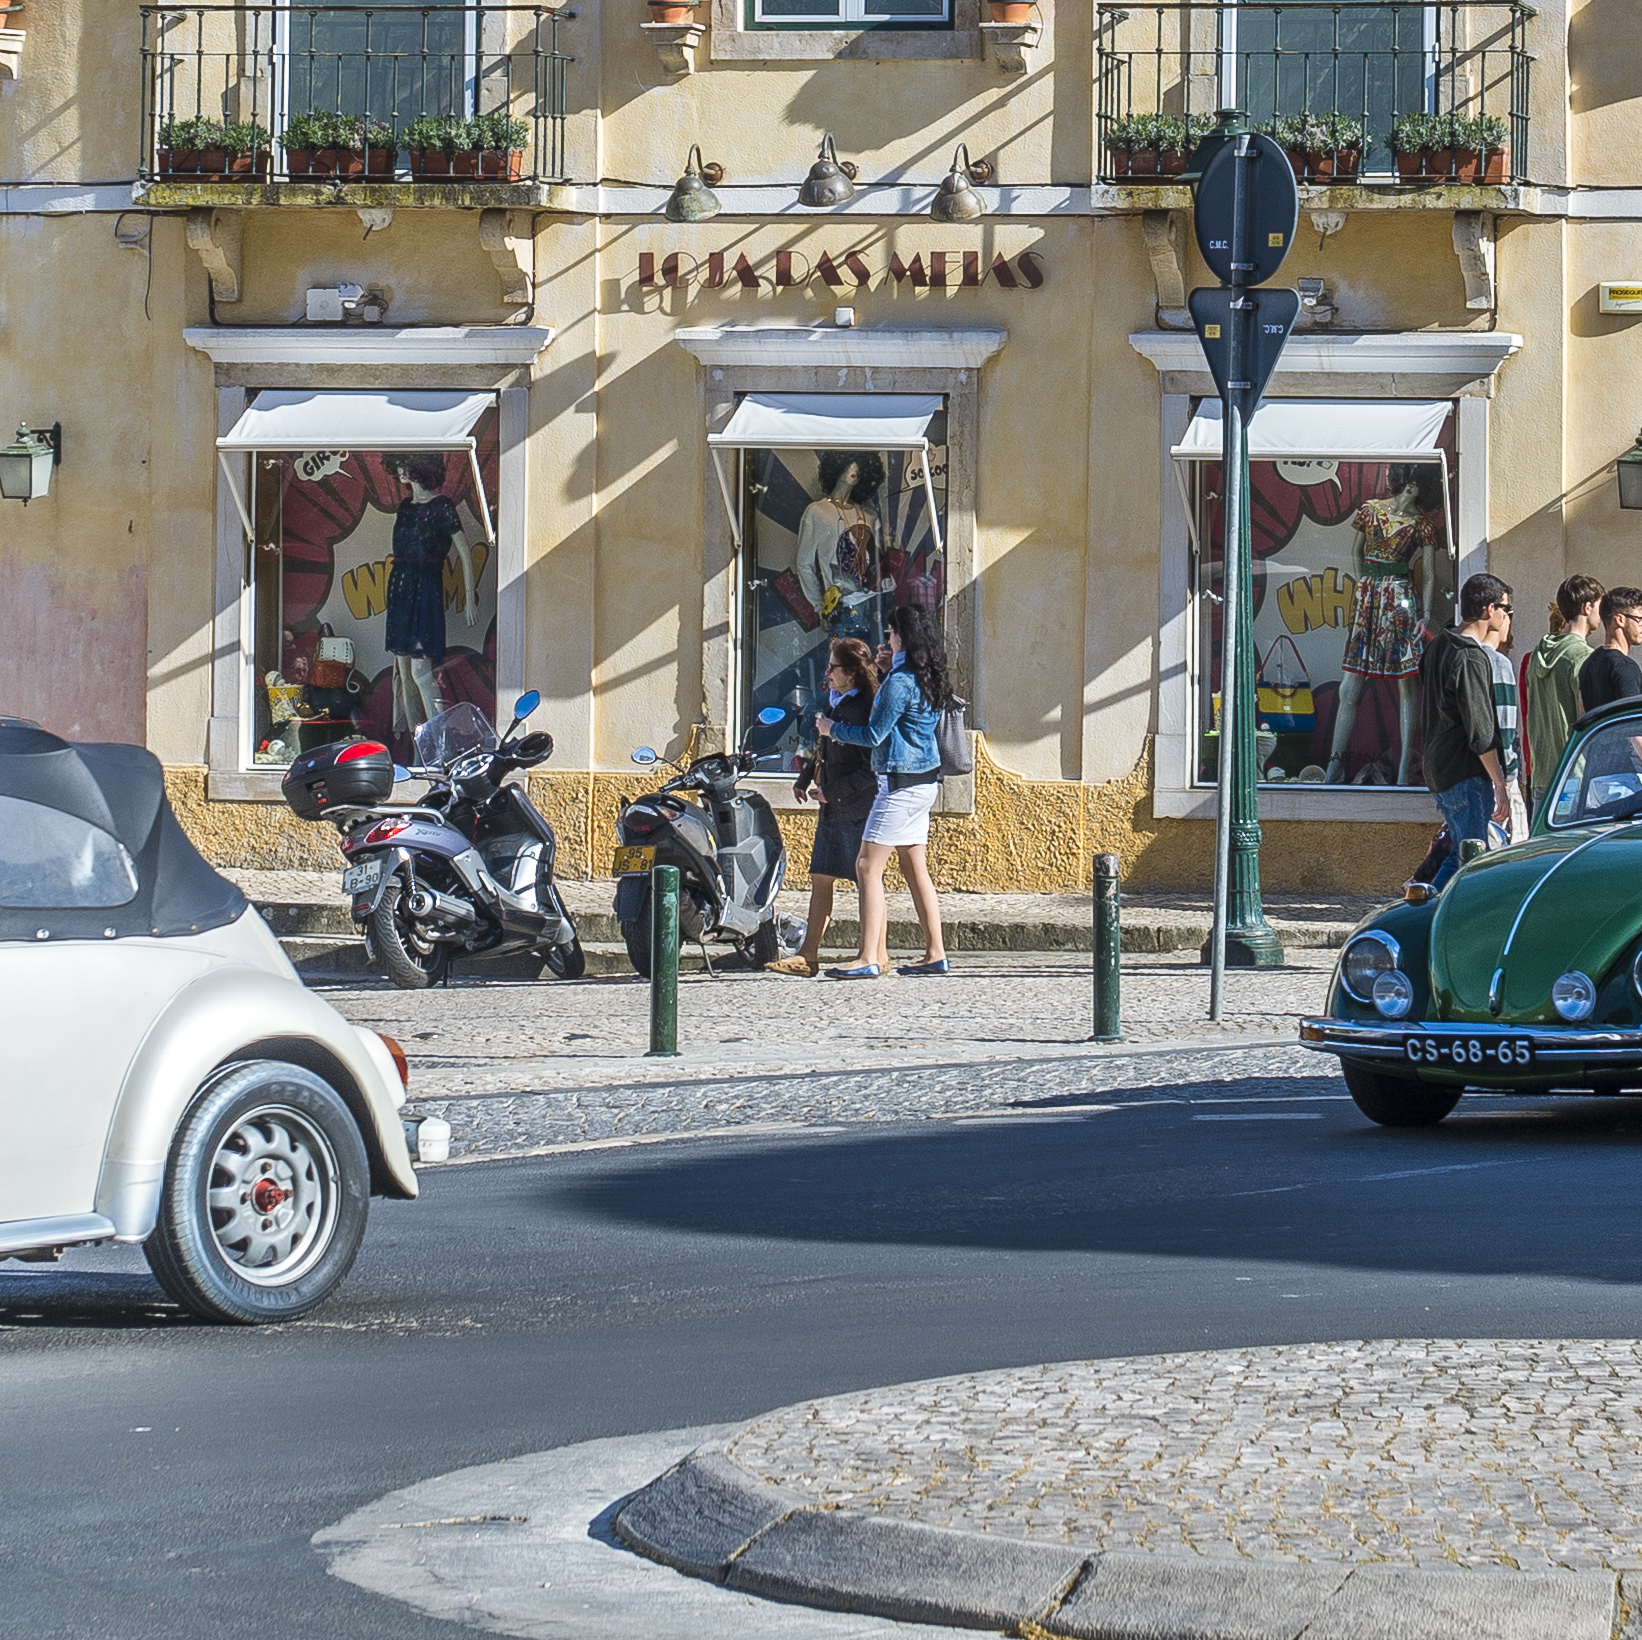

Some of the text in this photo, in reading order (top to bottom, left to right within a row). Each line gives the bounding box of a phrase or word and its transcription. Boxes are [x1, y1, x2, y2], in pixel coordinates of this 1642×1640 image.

[638, 250, 762, 288] LOJA
[775, 248, 872, 288] DAS
[357, 864, 368, 877] 31
[1407, 1038, 1531, 1064] CS-68-65
